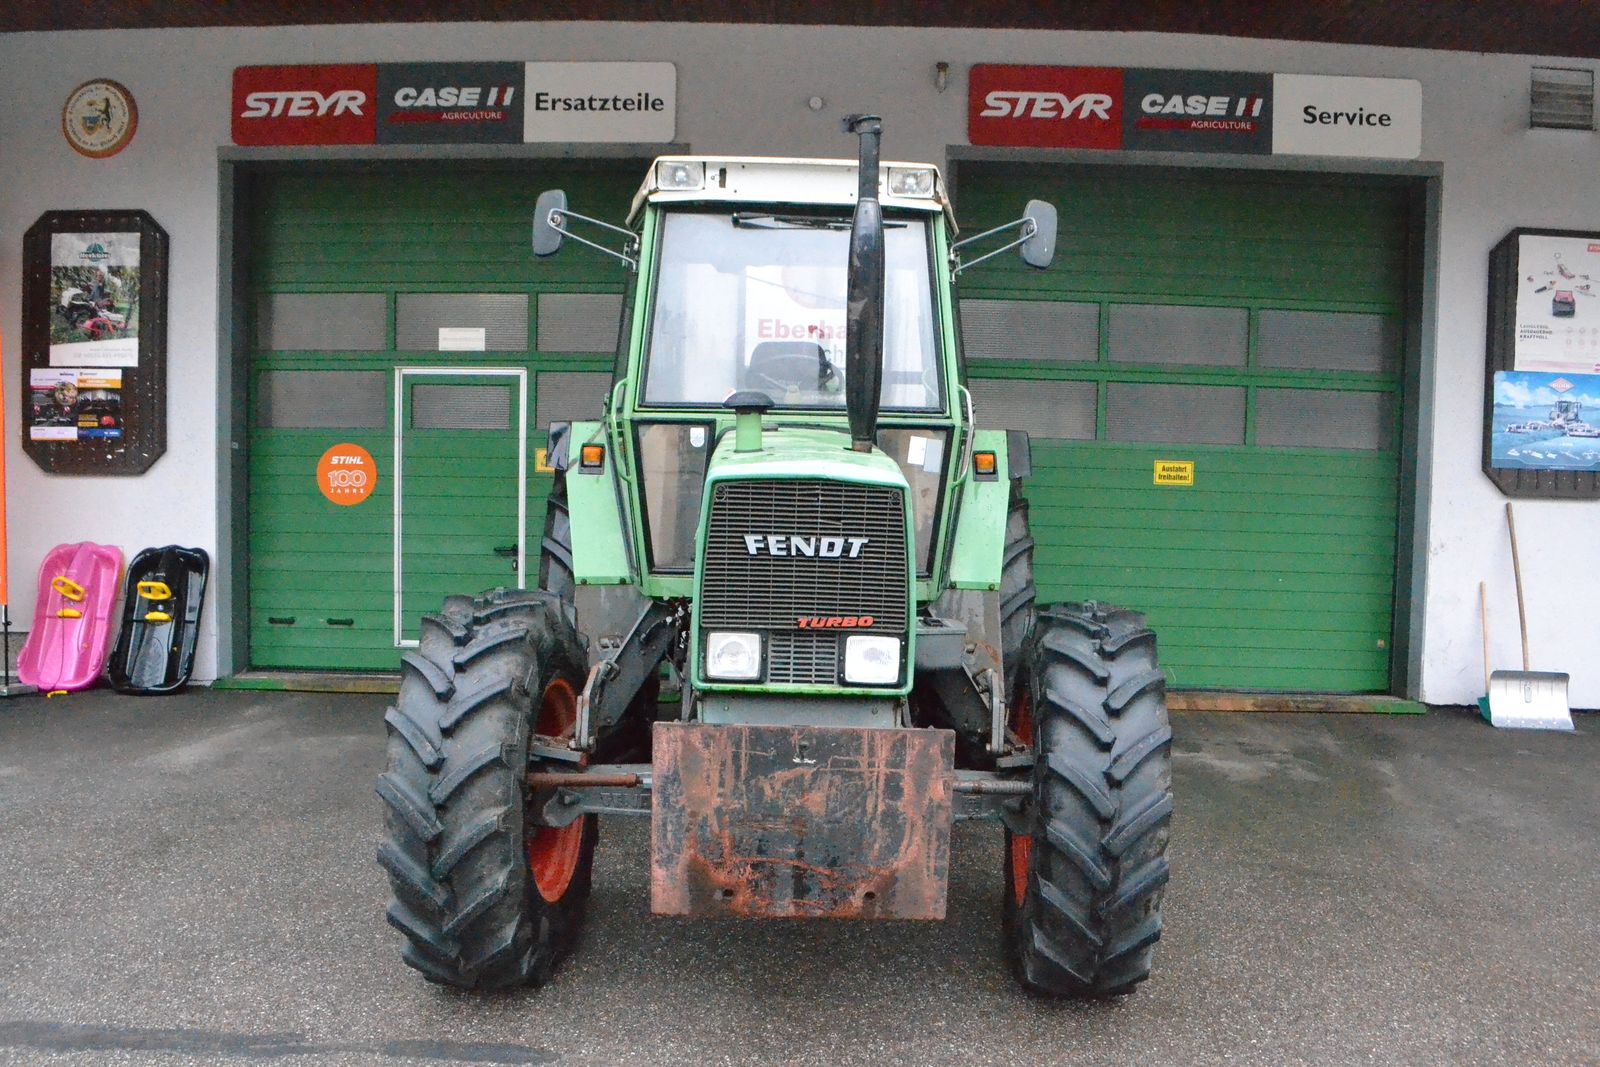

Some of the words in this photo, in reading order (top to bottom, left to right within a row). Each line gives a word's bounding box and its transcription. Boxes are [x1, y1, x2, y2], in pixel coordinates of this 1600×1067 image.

[240, 90, 366, 117] STEYR
[394, 87, 481, 107] CASE
[535, 92, 664, 111] Ersatzteile
[980, 91, 1112, 120] STEYR
[1141, 93, 1230, 115] CASE
[442, 112, 502, 120] AGRICULTURE
[1303, 105, 1391, 126] Service
[1191, 121, 1251, 130] AGRICULTURE
[331, 455, 364, 464] STIHL
[1161, 464, 1187, 472] Ausfahrt
[328, 469, 367, 487] 100
[1158, 473, 1190, 481] freihalten!
[743, 534, 870, 558] FENDT
[798, 616, 874, 629] TURBO
